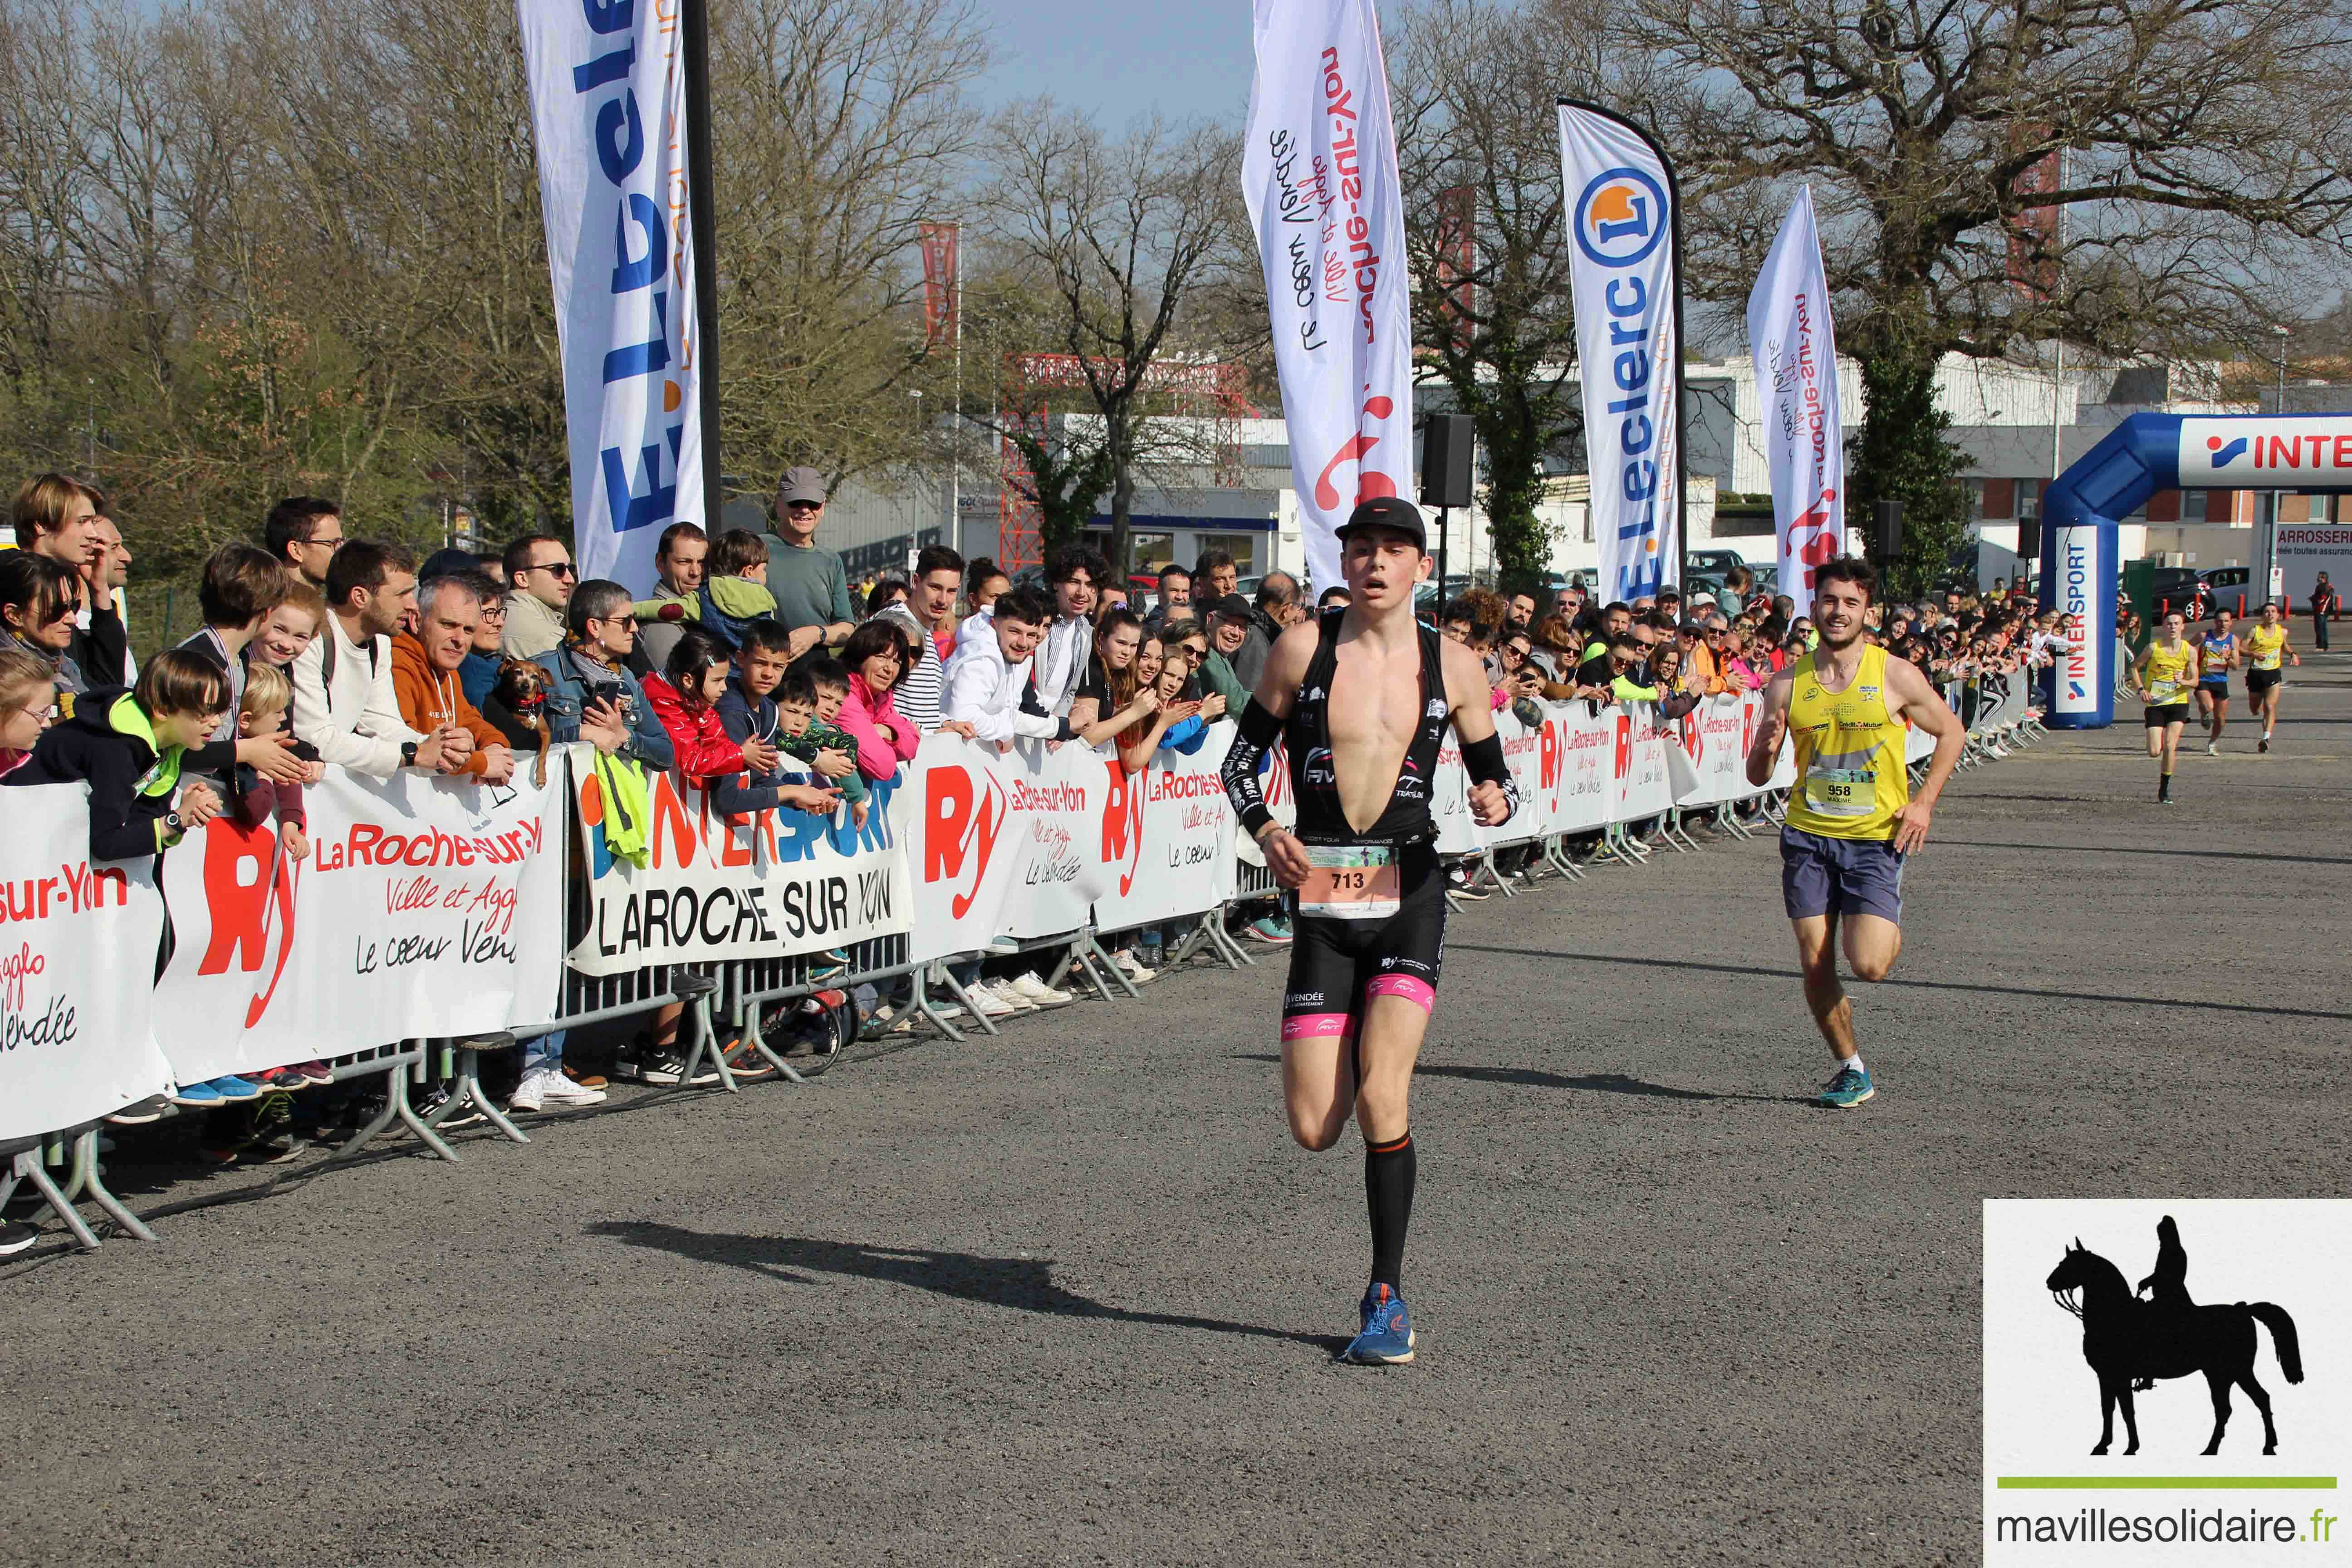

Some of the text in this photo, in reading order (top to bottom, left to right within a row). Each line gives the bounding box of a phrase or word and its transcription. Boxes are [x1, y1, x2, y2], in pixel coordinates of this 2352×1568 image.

[1605, 277, 1661, 601] E.Leclerc
[2254, 436, 2352, 469] INTE
[2278, 530, 2352, 544] ARROSSERI
[2068, 543, 2085, 678] INERSPORT
[1573, 727, 1609, 749] Roche-sur-Yon
[1828, 785, 1851, 796] 958
[652, 767, 903, 870] NTERSPORT
[315, 816, 542, 872] La Roche-sur-Y
[783, 876, 848, 938] SUR
[858, 867, 891, 928] YON
[1331, 872, 1364, 889] 713
[387, 874, 518, 935] Ville et Agg
[357, 935, 377, 974] Le
